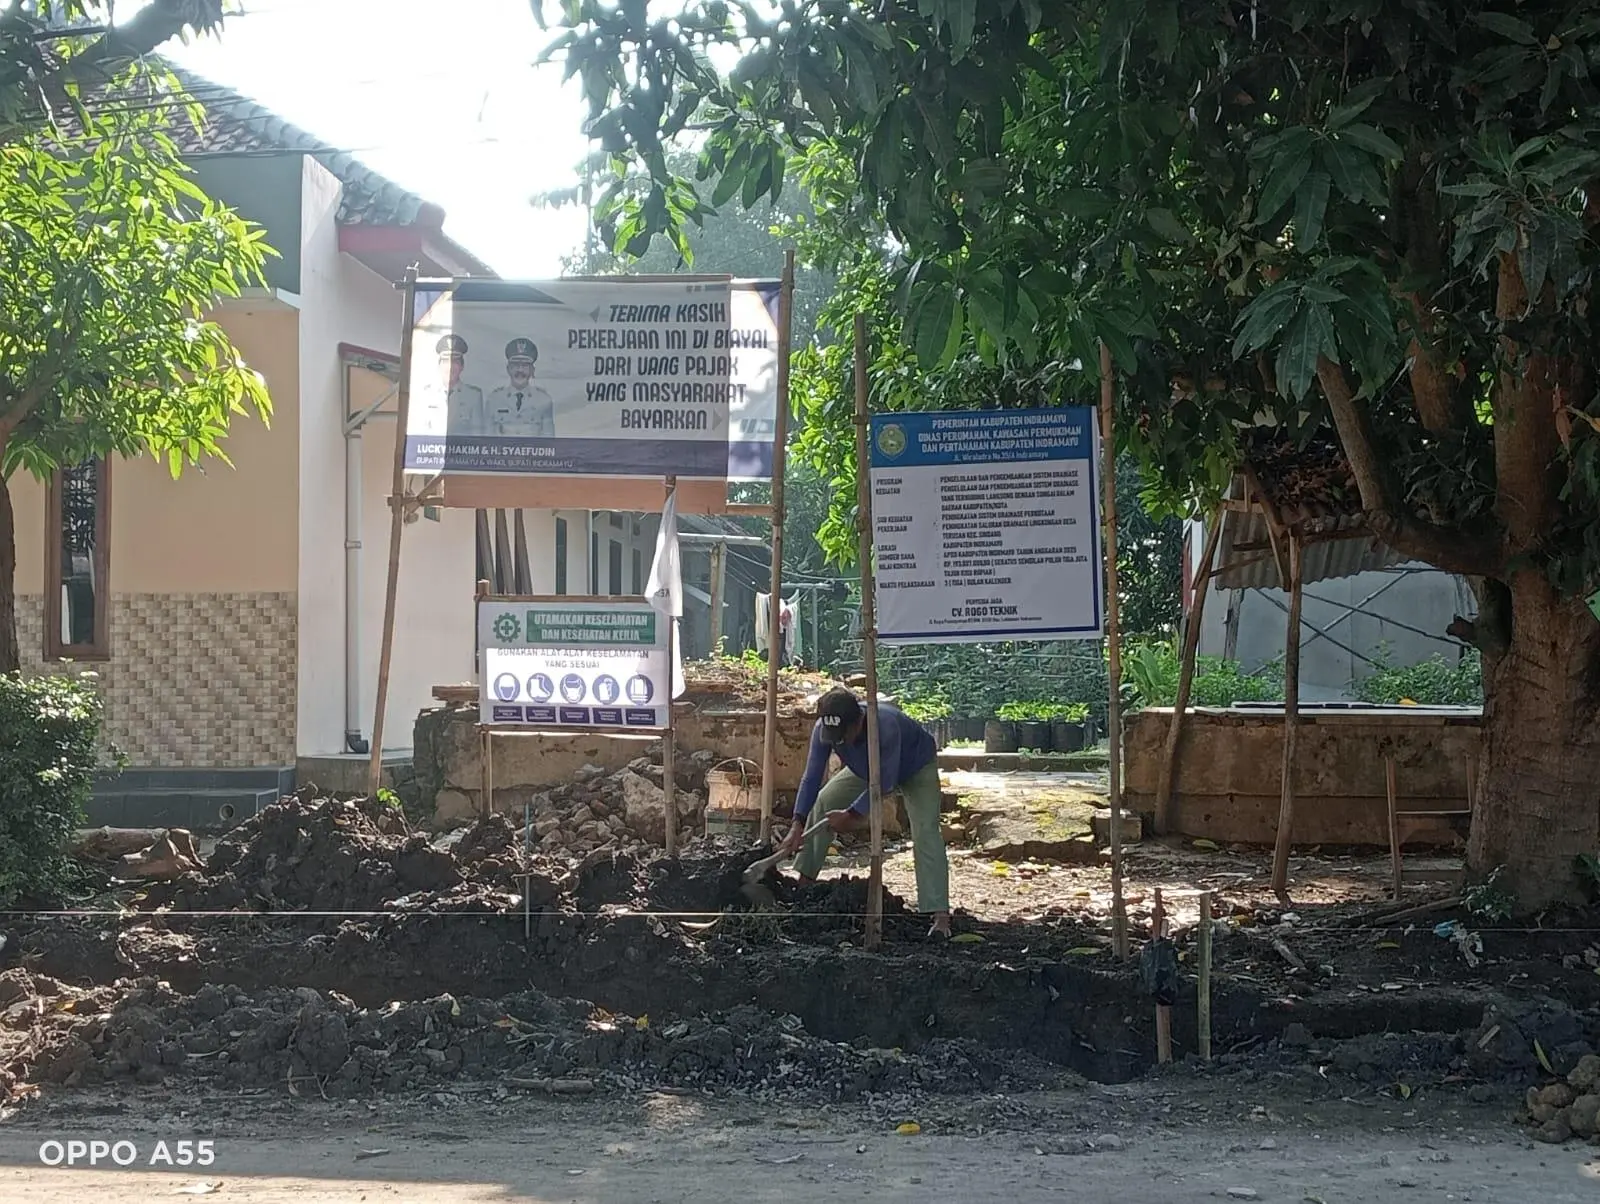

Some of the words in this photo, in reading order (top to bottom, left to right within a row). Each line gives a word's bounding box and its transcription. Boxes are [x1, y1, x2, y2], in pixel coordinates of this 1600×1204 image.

[609, 304, 670, 322] TERIMA
[676, 303, 725, 322] KASIH
[568, 329, 659, 349] PEKERJAAN
[665, 330, 686, 349] INI
[693, 330, 709, 348] DI
[714, 330, 768, 349] BIAYAI
[594, 356, 630, 376] DARI
[638, 356, 679, 376] UANG
[685, 356, 738, 376] PAJAK
[586, 382, 626, 401] YANG
[632, 383, 746, 403] MASYARAKAT
[621, 409, 707, 430] BAYARKAN
[980, 416, 1023, 427] KABUPATEN
[1024, 414, 1067, 426] INDRAMAYU
[918, 432, 941, 442] DINAS
[990, 438, 1034, 450] KABUPATEN
[1035, 437, 1078, 448] INDRAMAYU
[417, 444, 446, 454] LUCKY
[450, 446, 479, 455] HAKIM
[481, 446, 488, 455] &
[491, 447, 500, 456] H.
[951, 608, 963, 617] CV.
[989, 606, 1018, 616] TEKNIK
[534, 614, 584, 625] UTAMAKAN
[585, 614, 648, 626] KESELAMATAN
[542, 630, 560, 640] DAN
[561, 629, 611, 641] KESEHATAN
[613, 630, 640, 641] KERJA
